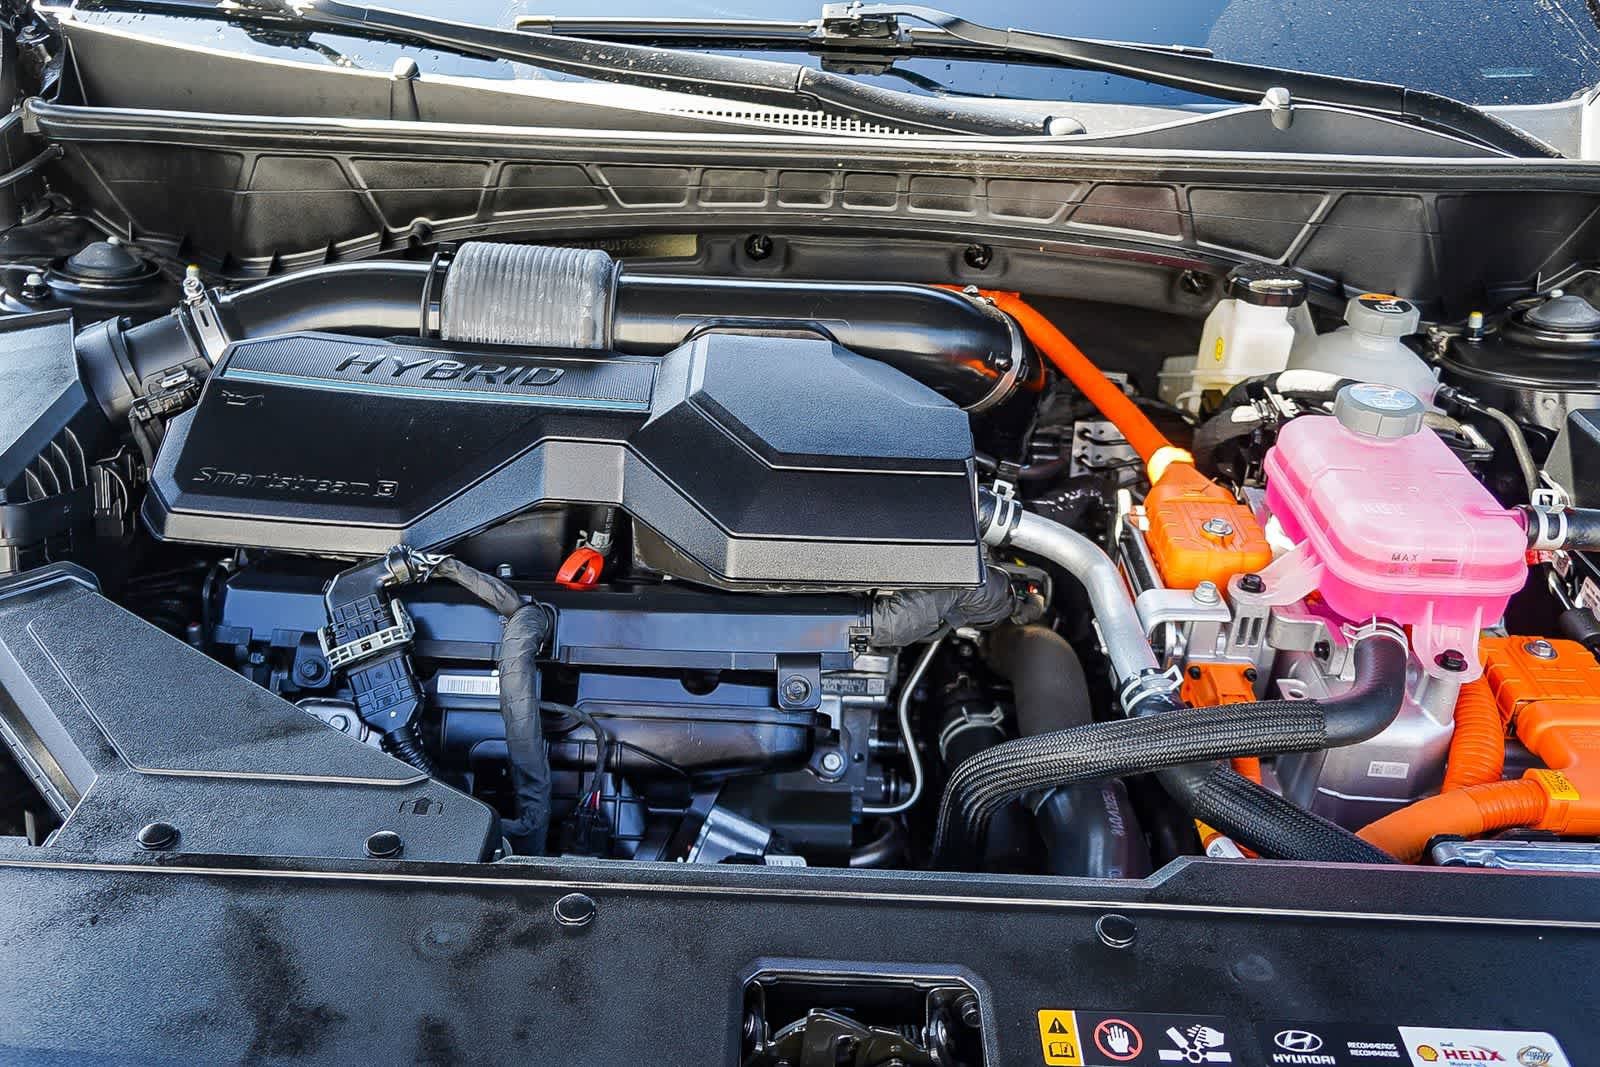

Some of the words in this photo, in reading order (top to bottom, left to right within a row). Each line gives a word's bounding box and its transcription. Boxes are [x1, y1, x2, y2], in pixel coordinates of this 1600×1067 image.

[336, 352, 565, 386] HYBRID
[192, 467, 370, 495] Smartstream
[1391, 552, 1418, 562] MAX
[1273, 1053, 1336, 1065] HYUNDAI
[1443, 1049, 1506, 1062] HELIX
